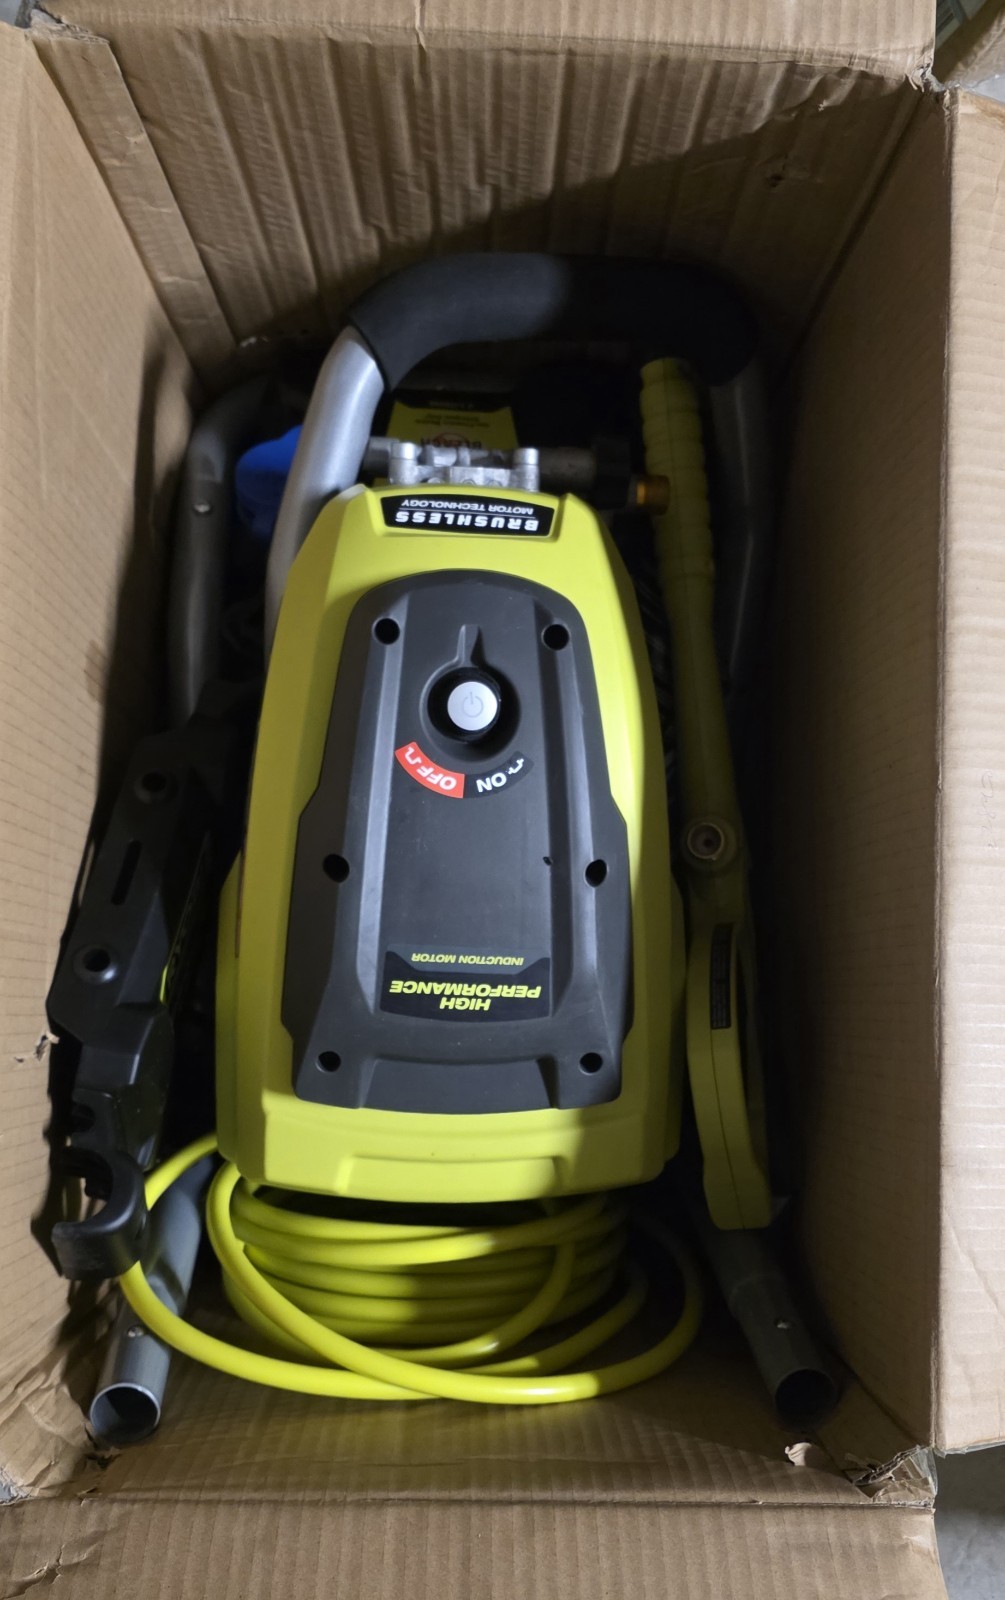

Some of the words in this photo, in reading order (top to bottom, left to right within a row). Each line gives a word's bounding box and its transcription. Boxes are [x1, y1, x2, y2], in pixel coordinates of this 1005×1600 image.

[401, 499, 486, 512] TECHNOLOGY
[488, 504, 534, 515] MOTOR
[395, 511, 539, 531] BRUSHLESS
[416, 765, 457, 791] OFF
[476, 772, 507, 793] ON
[411, 952, 457, 963] MOTOR
[458, 955, 525, 966] INDUCTION
[389, 980, 542, 998] PERFORMANCE
[439, 997, 492, 1011] HIGH
